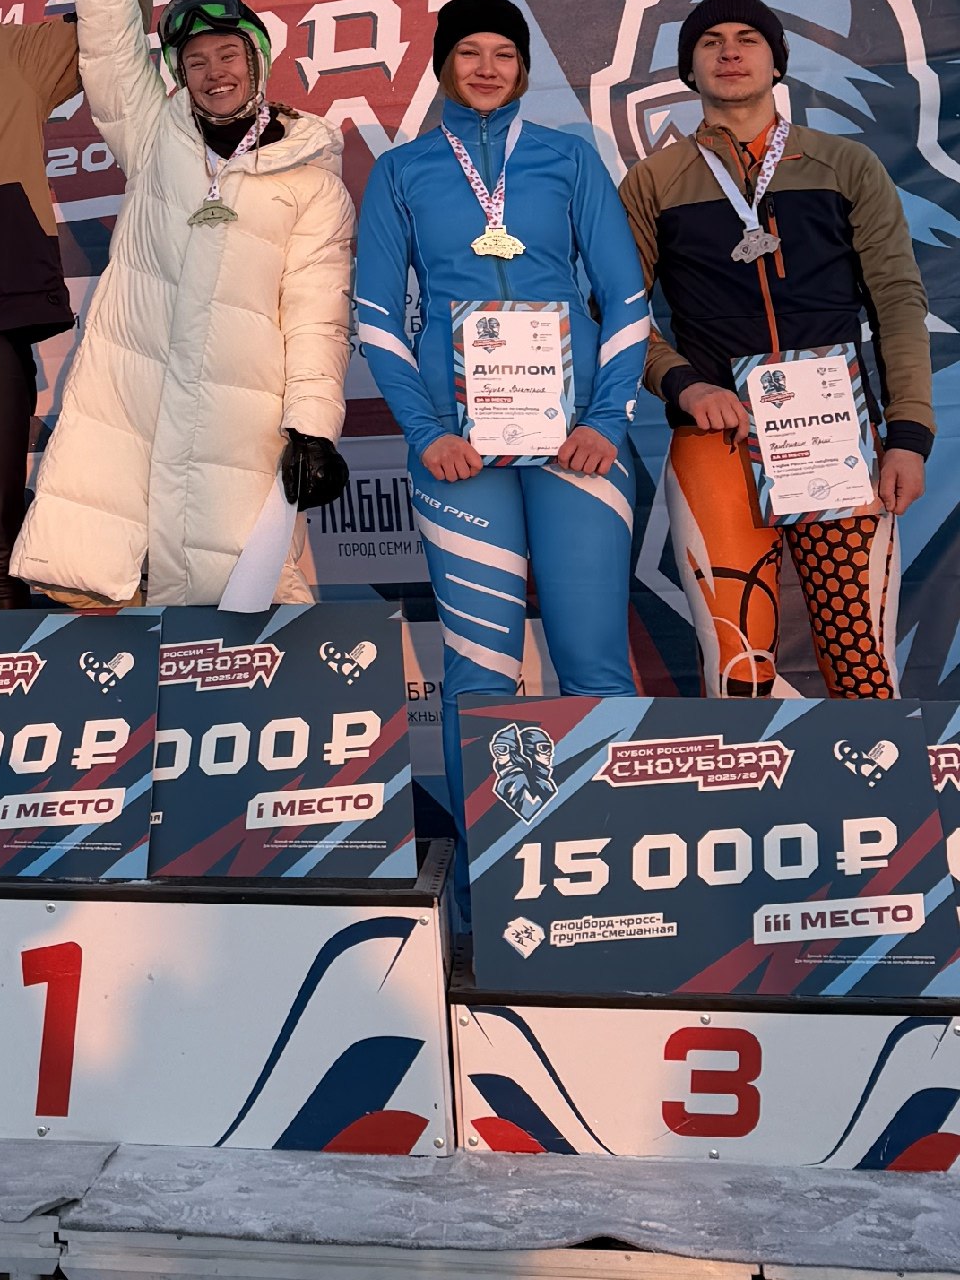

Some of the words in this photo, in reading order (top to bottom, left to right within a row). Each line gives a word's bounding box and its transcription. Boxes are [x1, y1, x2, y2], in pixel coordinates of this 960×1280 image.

[472, 364, 556, 376] ДИПЛОМ
[764, 411, 851, 433] ДИПЛОМ
[443, 505, 490, 528] PRO
[338, 542, 377, 558] ГОРОД
[379, 541, 412, 555] СЕМИ
[160, 652, 272, 676] ОУБОРД
[162, 649, 204, 658] РОССИИ
[205, 672, 250, 682] 2025/26
[617, 748, 654, 758] КУБОК
[657, 745, 703, 755] РОССИИ
[611, 749, 782, 777] СНОУБОРД
[707, 772, 758, 782] 2025/26
[15, 798, 115, 819] МЕСТО
[272, 793, 374, 818] МЕСТО
[513, 837, 612, 900] 15
[801, 905, 914, 930] МЕСТО
[553, 925, 675, 943] группа-смешанная
[21, 941, 83, 1117] 1
[662, 1026, 763, 1138] 3
